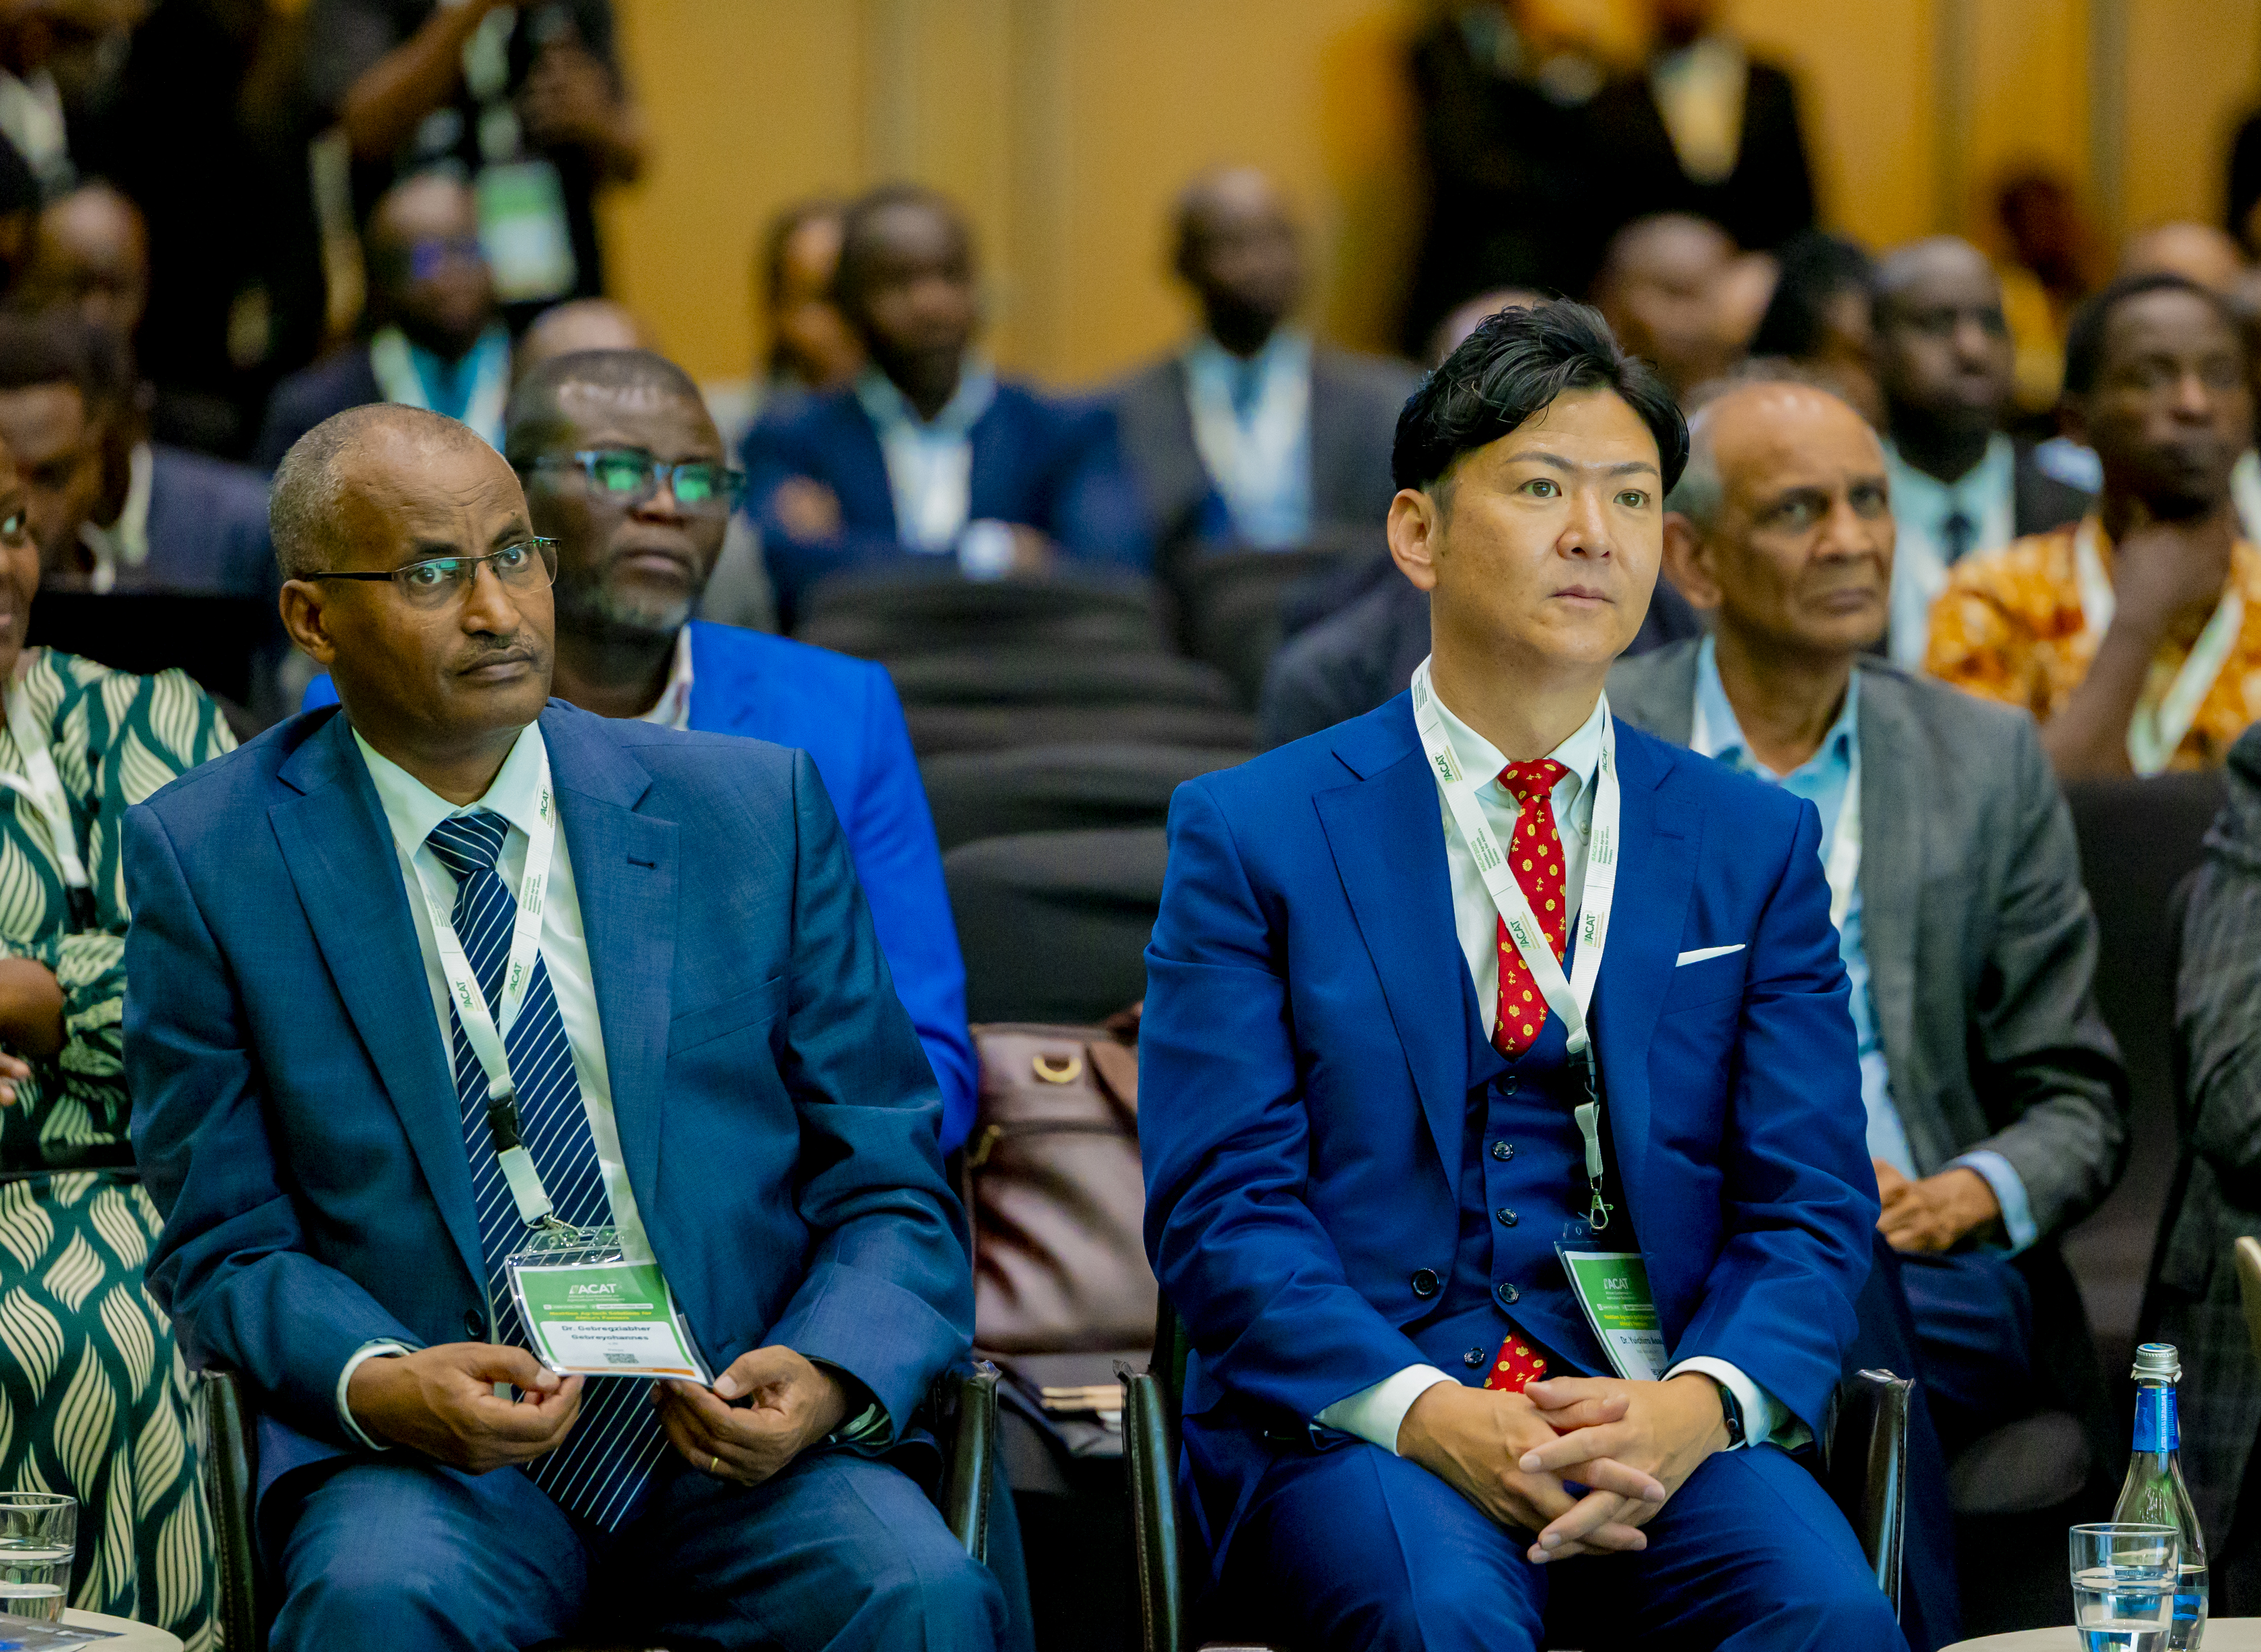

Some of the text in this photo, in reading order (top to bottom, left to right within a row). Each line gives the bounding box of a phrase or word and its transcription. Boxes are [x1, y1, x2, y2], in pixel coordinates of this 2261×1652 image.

[1435, 755, 1452, 778] ACAT
[540, 789, 549, 816] ACAT
[1471, 841, 1487, 872] #ACAT2025
[1510, 921, 1529, 944] ACAT
[1585, 914, 1595, 940] ACAT
[510, 962, 522, 991] ACAT
[456, 981, 472, 1005] ACAT
[578, 1283, 616, 1294] ACAT
[1608, 1278, 1628, 1289] ACAT
